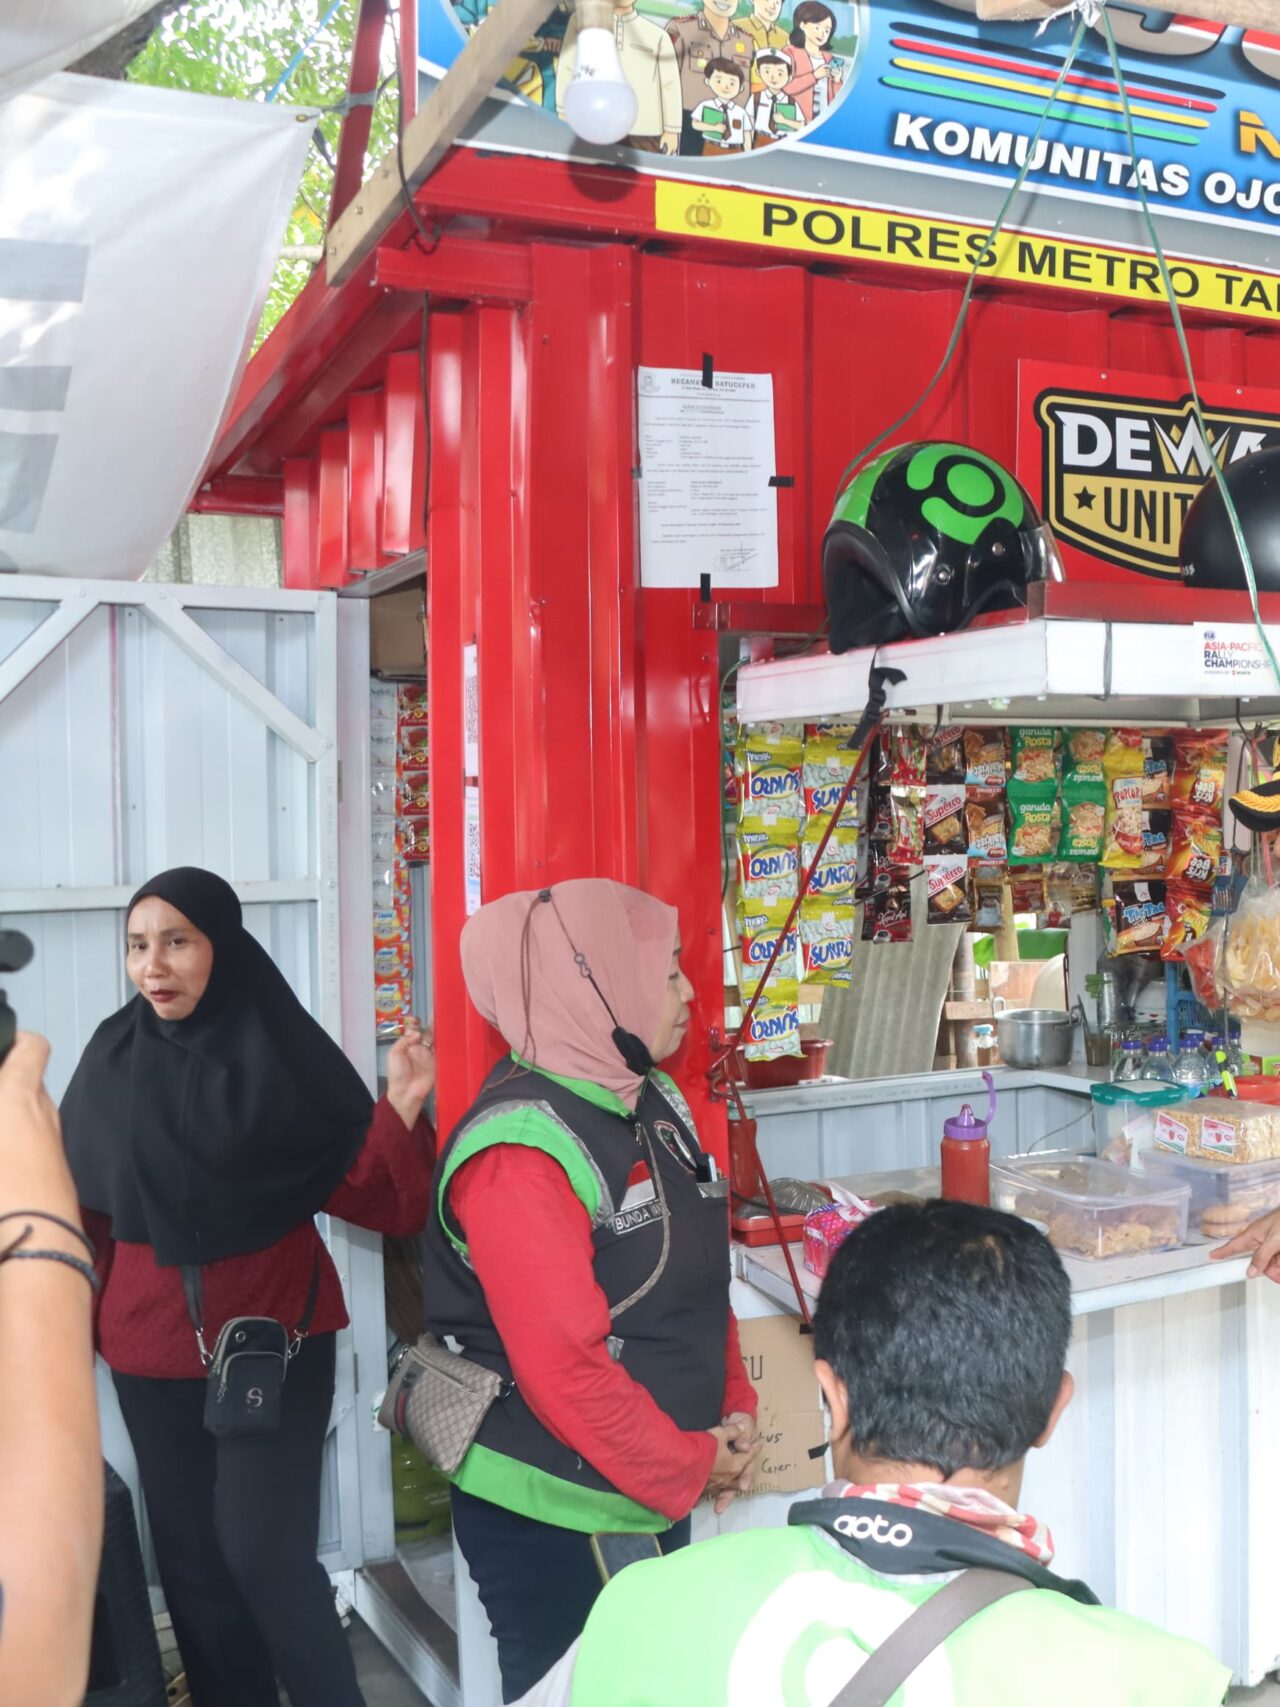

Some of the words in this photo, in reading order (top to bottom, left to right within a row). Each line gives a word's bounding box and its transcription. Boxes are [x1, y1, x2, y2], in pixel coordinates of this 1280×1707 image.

[893, 111, 1191, 197] KOMUNITAS
[762, 201, 998, 269] POLRES
[1017, 240, 1200, 298] METRO
[1055, 409, 1268, 478] DEWA
[1103, 485, 1195, 545] UNIT
[1204, 650, 1234, 660] RALLY
[1019, 728, 1052, 738] garuda
[750, 770, 800, 797] SUKRO
[812, 785, 858, 811] SUKO
[926, 796, 962, 821] Superco
[1020, 803, 1051, 813] garuda
[750, 849, 798, 878] SUKRO
[751, 1010, 800, 1041] SUKRO
[615, 1208, 651, 1231] BUNDA
